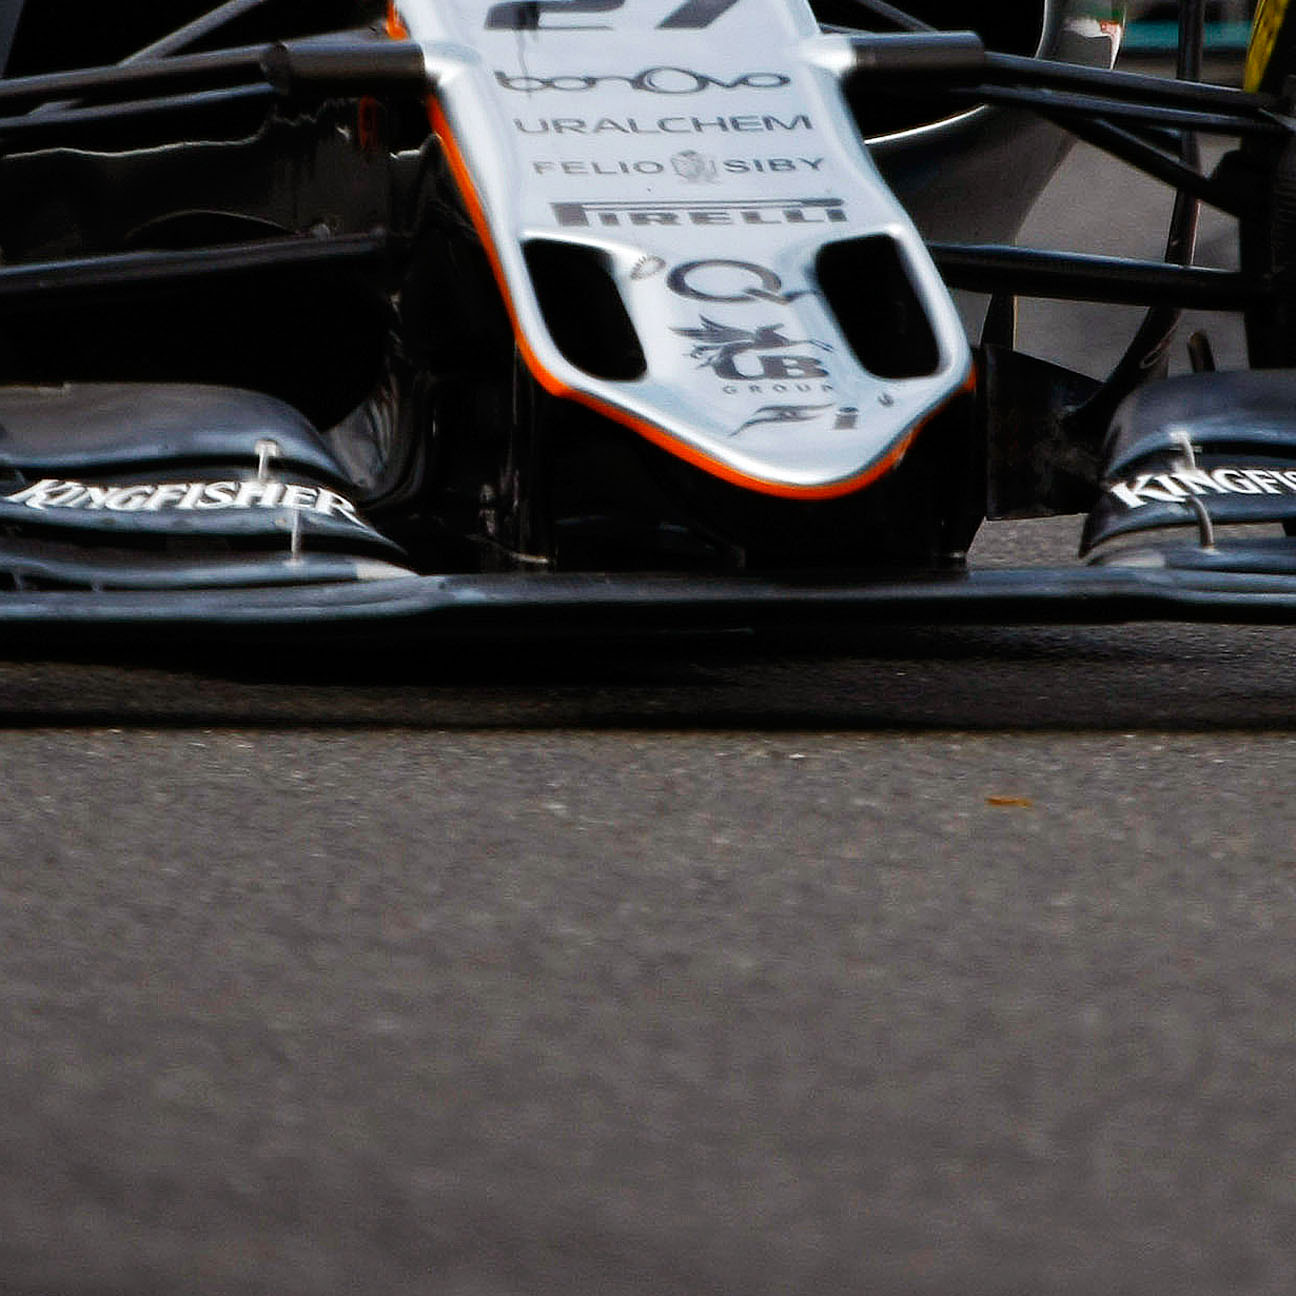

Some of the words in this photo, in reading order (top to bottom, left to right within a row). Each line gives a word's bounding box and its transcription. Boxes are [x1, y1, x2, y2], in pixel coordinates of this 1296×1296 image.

[512, 114, 814, 135] URALCHEM
[532, 159, 665, 176] FELIO
[722, 157, 826, 174] SIBY
[549, 197, 848, 227] PIRELLI
[4, 478, 366, 523] KINGFISHER
